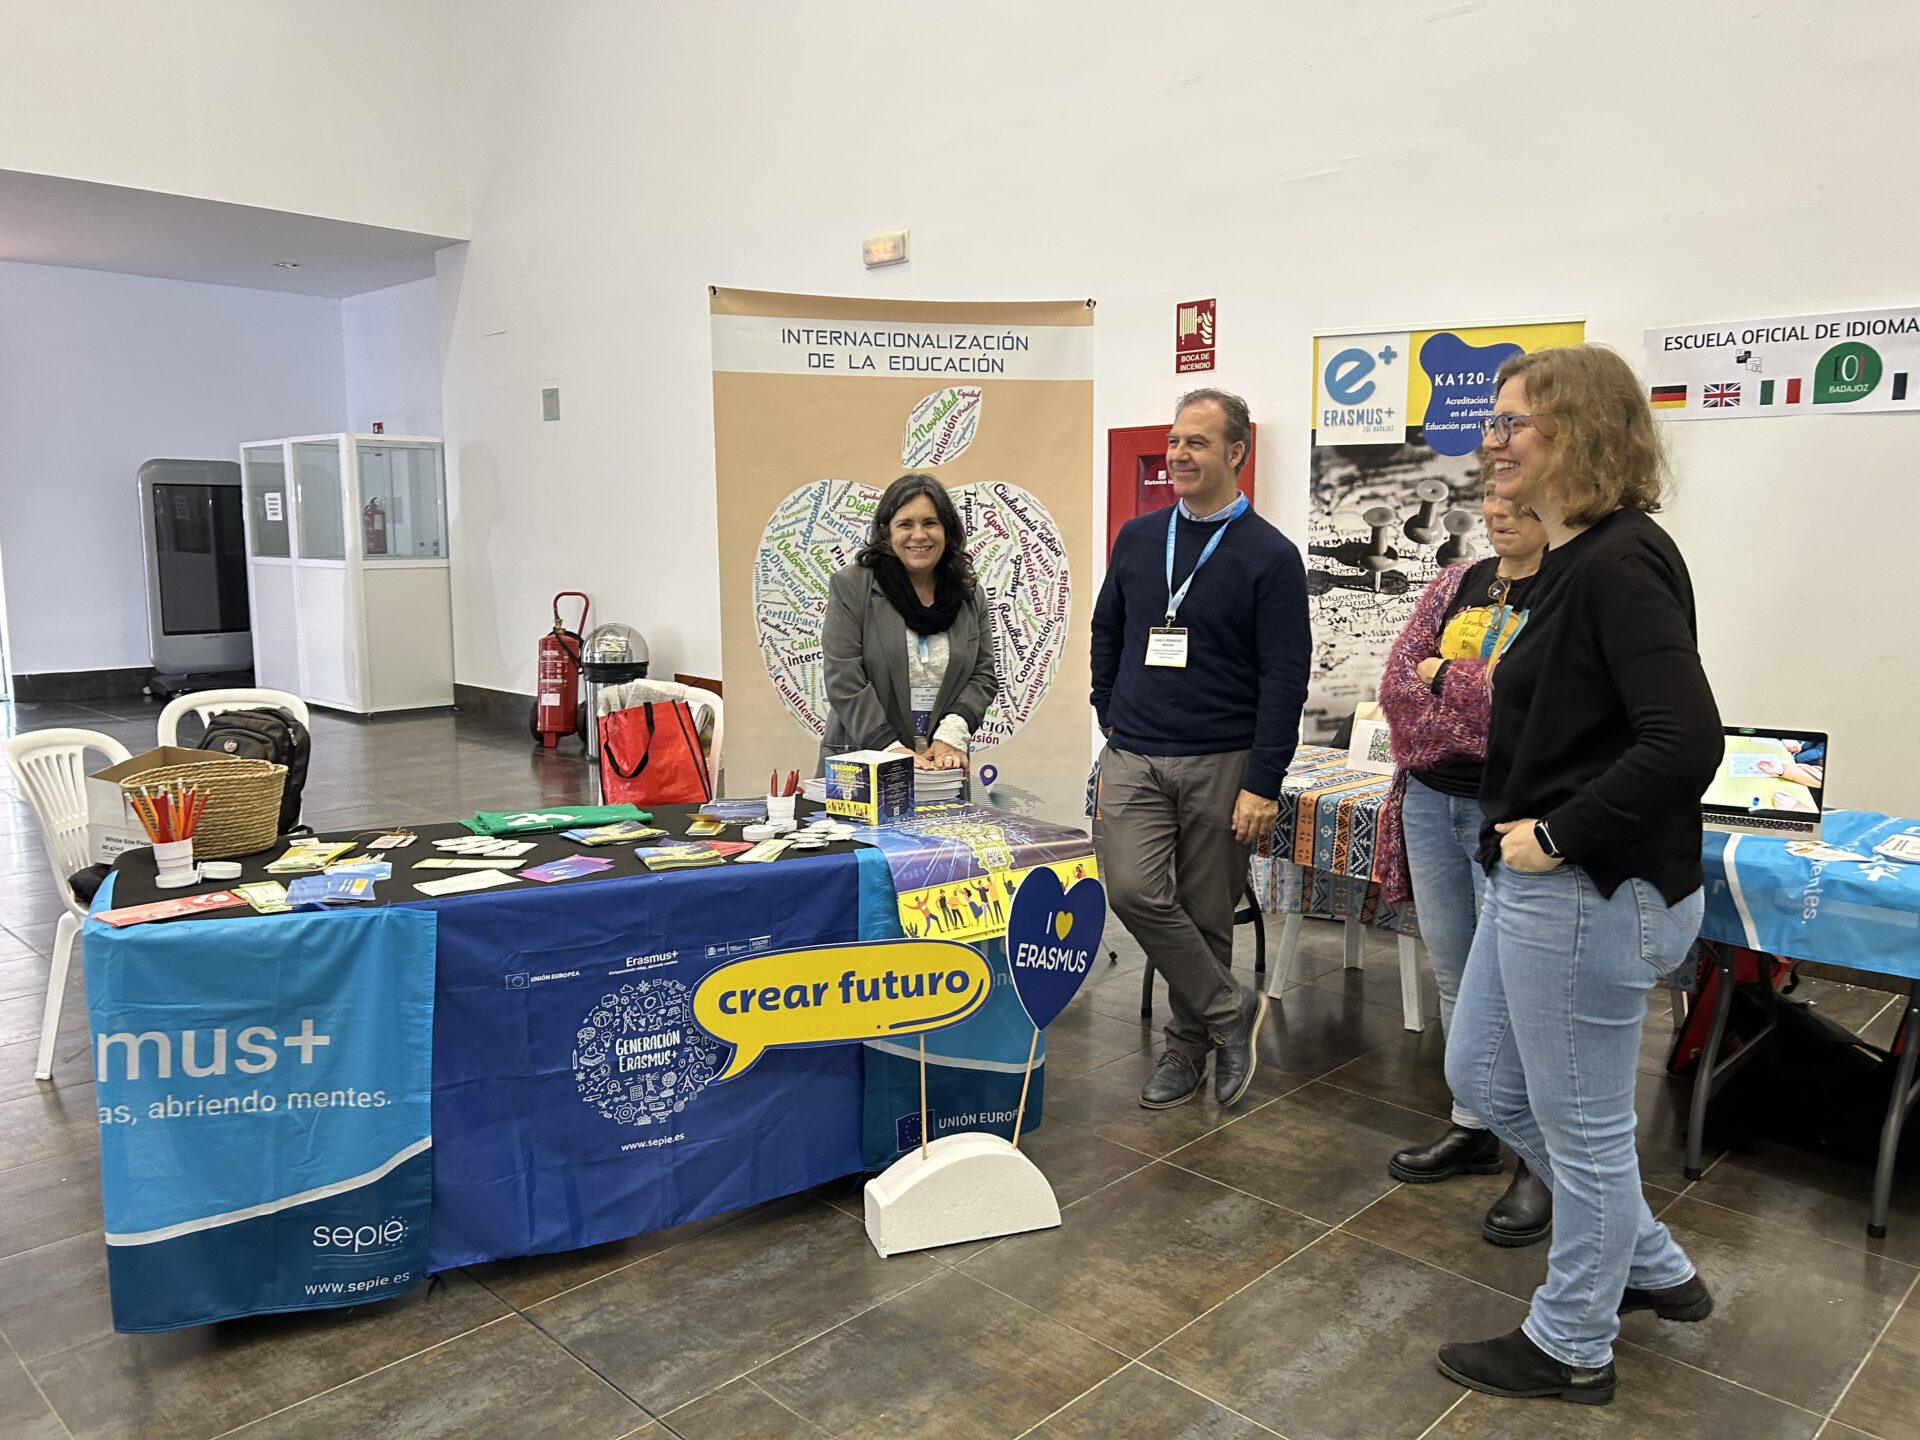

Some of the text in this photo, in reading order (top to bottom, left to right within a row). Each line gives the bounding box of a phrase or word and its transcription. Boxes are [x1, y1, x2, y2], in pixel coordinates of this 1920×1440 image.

[781, 328, 1029, 351] INTERNACIONALIZACIÓN
[1664, 317, 1920, 351] ESCUELA OFICIAL DE IDIOMA
[807, 352, 1004, 373] DE LA EDUCACIÓN
[1180, 352, 1210, 362] BOCA DE
[1180, 361, 1211, 372] INCENDIO
[1833, 354, 1865, 383] EOI
[1445, 395, 1488, 406] Acreditación
[1828, 383, 1869, 394] BADAJOZ
[911, 388, 959, 442] Movilidad
[1323, 407, 1395, 427] ERASMUS+
[1425, 420, 1477, 431] Educación para
[1450, 408, 1493, 418] en el ámbito
[928, 414, 959, 466] Inclusión
[829, 480, 855, 513] Cooperación
[794, 480, 828, 554] Intercambios
[959, 490, 978, 537] Impacto
[983, 510, 1010, 540] Apoyo
[994, 483, 1038, 532] Ciudadanía
[1037, 532, 1062, 558] activa
[760, 548, 772, 585] Redes
[1018, 528, 1038, 582] Cohesión
[1029, 583, 1046, 617] social
[1030, 541, 1055, 578] Unión
[769, 554, 813, 610] Diversidad
[1004, 554, 1024, 600] Impacto
[1053, 569, 1069, 623] Sinergias
[790, 635, 822, 652] Calid
[998, 601, 1028, 662] Resultados
[787, 650, 824, 667] Interc
[1015, 619, 1055, 684] Cooperación
[1016, 649, 1054, 723] Investigación
[1046, 911, 1052, 935] I
[625, 950, 679, 968] Erasmus+
[1016, 942, 1088, 973] ERASMUS
[530, 970, 580, 983] UNIÓN EUROPEA
[718, 968, 970, 1016] crear futuro
[98, 1018, 330, 1083] mus+
[615, 1029, 681, 1057] GENERACIÓN
[618, 1050, 678, 1073] ERASMUS+
[98, 1086, 392, 1126] as, abriendo mentes.
[938, 1105, 1025, 1130] UNIÓN EUROP
[620, 1132, 685, 1152] www.sepie.es
[312, 1220, 404, 1253] sepie
[305, 1271, 410, 1295] www.sepie.es
